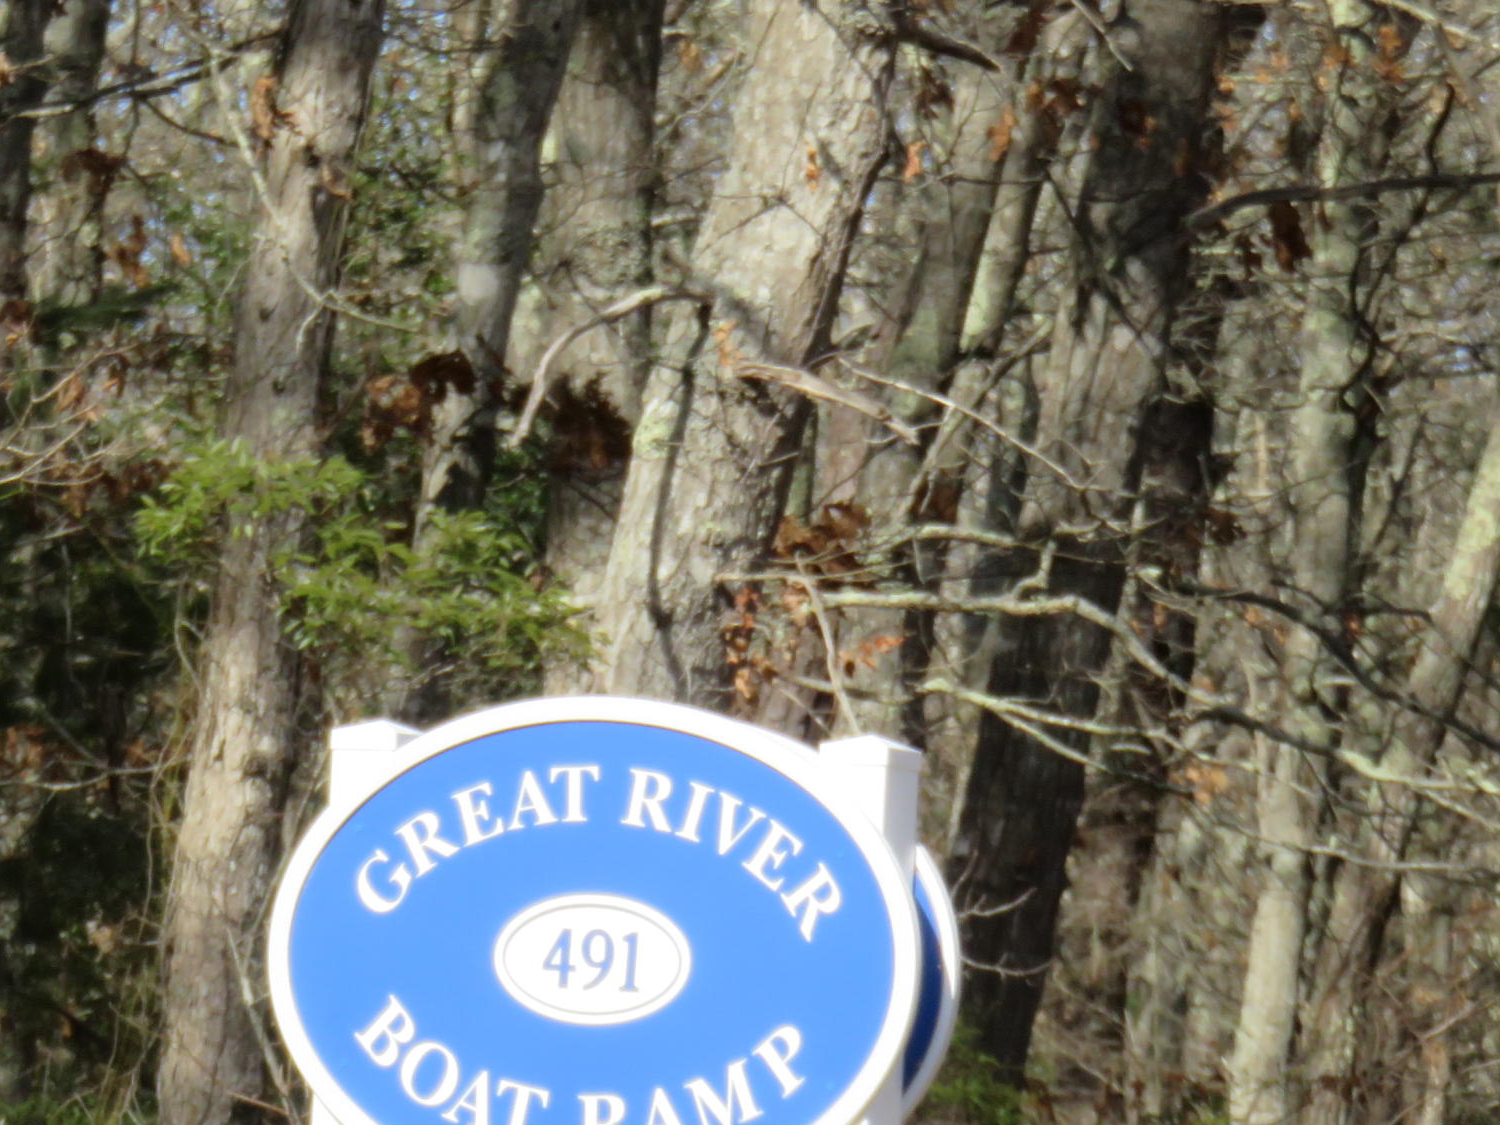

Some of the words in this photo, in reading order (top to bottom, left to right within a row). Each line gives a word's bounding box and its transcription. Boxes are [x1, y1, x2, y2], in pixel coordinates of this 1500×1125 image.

[356, 765, 600, 914] GREAT
[620, 767, 842, 942] RIVER
[542, 927, 640, 993] 491
